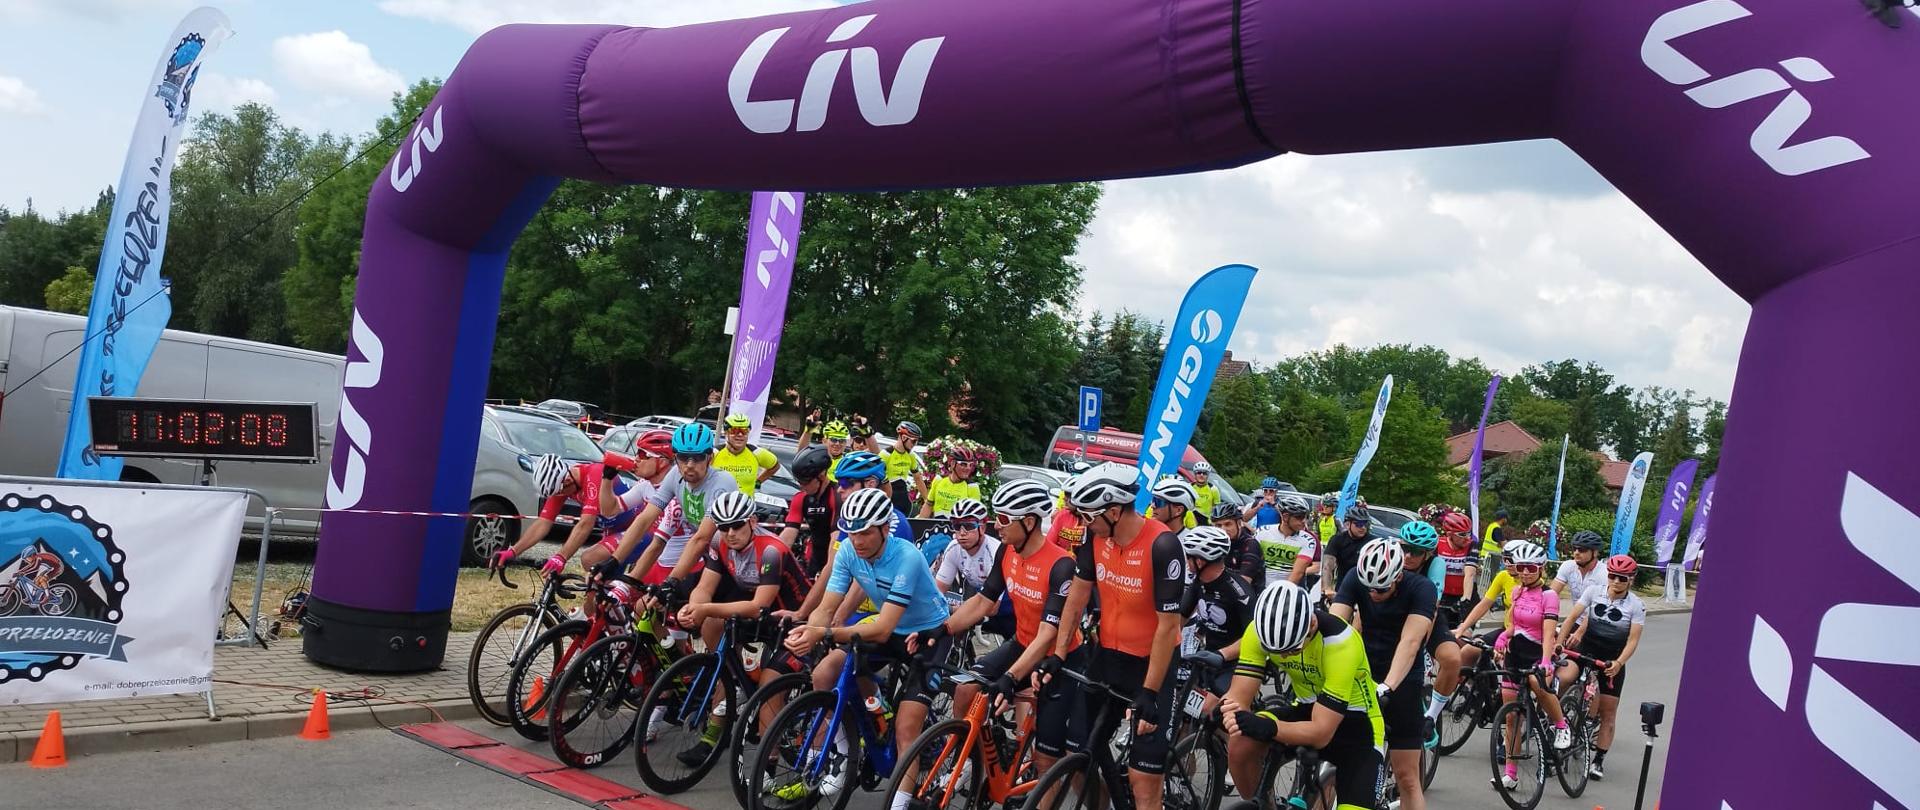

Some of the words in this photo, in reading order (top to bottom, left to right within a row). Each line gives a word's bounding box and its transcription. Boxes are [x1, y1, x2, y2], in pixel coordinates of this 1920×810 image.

[1085, 392, 1097, 426] P
[1141, 344, 1203, 492] GIANT
[130, 412, 288, 447] 11:02:08
[1097, 436, 1140, 449] ROWERY
[1106, 571, 1142, 587] ProTOUR
[84, 682, 114, 691] e-mail:
[1187, 691, 1206, 710] 217
